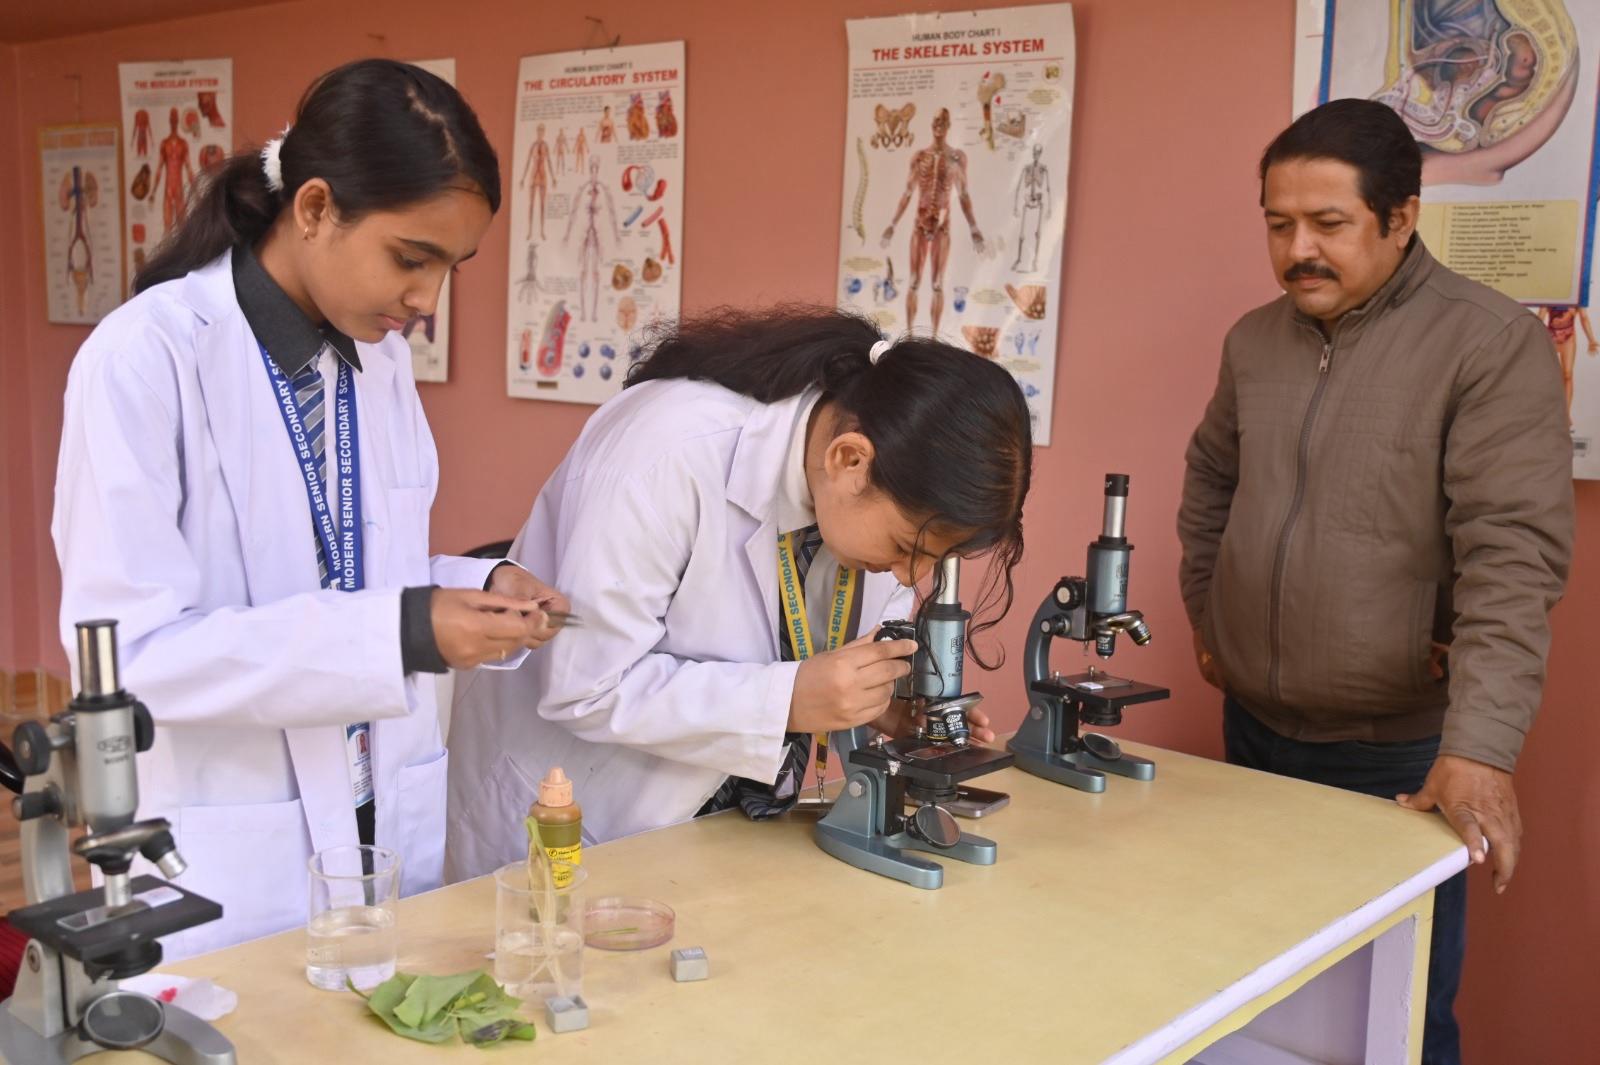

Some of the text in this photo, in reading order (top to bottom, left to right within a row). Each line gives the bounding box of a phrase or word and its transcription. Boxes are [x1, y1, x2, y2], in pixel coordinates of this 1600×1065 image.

[872, 39, 1045, 62] THE SKELETAL SYSTEM
[911, 32, 941, 42] HUMAN
[943, 30, 965, 40] BODY
[967, 28, 995, 38] CHART
[524, 69, 678, 91] THE CIRCULATORY SYSTEM
[276, 379, 311, 460] SECONDARY
[338, 398, 352, 474] SECONDARY
[304, 461, 326, 512] SENIOR
[342, 478, 354, 527] SENIOR
[320, 515, 341, 571] MODERN
[344, 532, 355, 589] MODERN
[778, 546, 800, 616] SECONDARY
[831, 590, 846, 633] SENIOR
